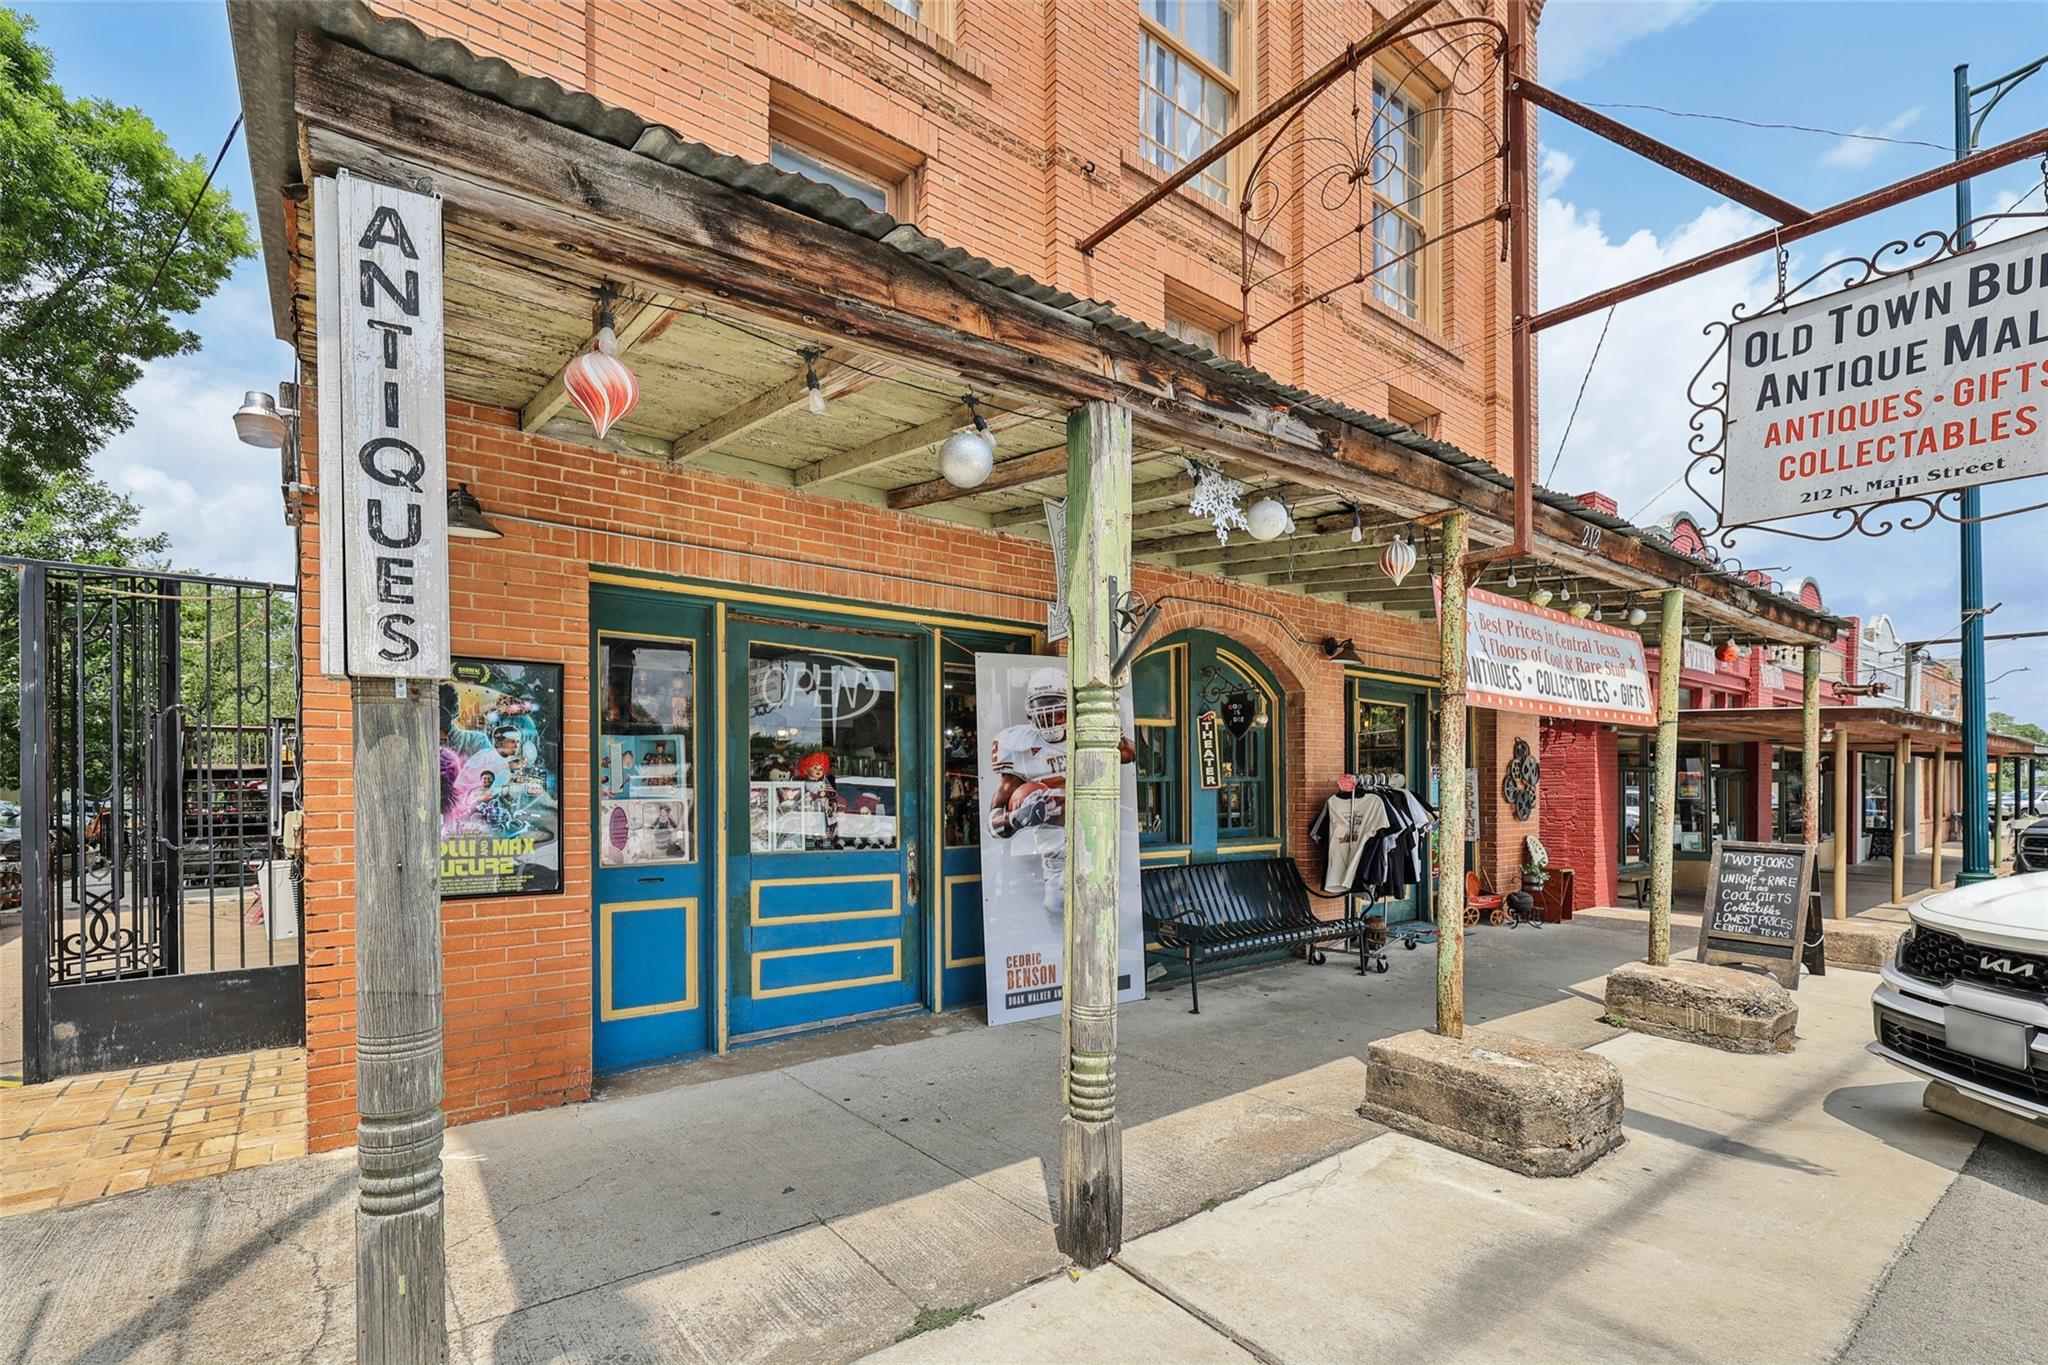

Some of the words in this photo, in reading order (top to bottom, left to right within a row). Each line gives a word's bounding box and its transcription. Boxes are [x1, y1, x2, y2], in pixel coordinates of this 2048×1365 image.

[1744, 324, 1812, 368] OLD
[1828, 281, 1951, 345] TOWN
[1756, 340, 1928, 412] ANTIQUE
[1764, 389, 1923, 449] ANTIQUES
[358, 205, 426, 662] ANTIQUES
[1779, 405, 2038, 482] COLLECTABLES
[1800, 488, 1833, 504] 212
[1840, 484, 1859, 496] N.
[1866, 473, 1919, 491] Main
[1926, 457, 2007, 482] Street
[1581, 525, 1601, 548] 212
[1479, 612, 1504, 637] Best
[1506, 619, 1543, 642] Prices
[1544, 626, 1554, 646] in
[1556, 630, 1592, 654] Central
[1593, 640, 1620, 658] Texas
[1490, 638, 1527, 661] Floors
[1531, 646, 1542, 663] of
[1544, 648, 1563, 669] Cool
[1565, 654, 1573, 671] &
[1576, 656, 1602, 674] Rare
[1604, 661, 1626, 678] Stuff
[1536, 669, 1610, 703] COLLECTIBLES
[1621, 683, 1645, 708] GIFTS
[1201, 721, 1216, 785] THEATER
[492, 838, 535, 855] MAX
[440, 857, 514, 877] UTURE
[1723, 853, 1752, 866] TWO
[1753, 855, 1794, 869] FLOORS
[1720, 873, 1757, 885] UNIQUE
[1767, 875, 1797, 888] RARE
[1756, 892, 1792, 904] GIFTS
[1758, 915, 1793, 930] PRICES
[1760, 927, 1790, 938] TEXAS
[1006, 952, 1042, 969] CEDRIC
[1007, 964, 1057, 990] BENSON
[1028, 991, 1052, 1003] WALKER
